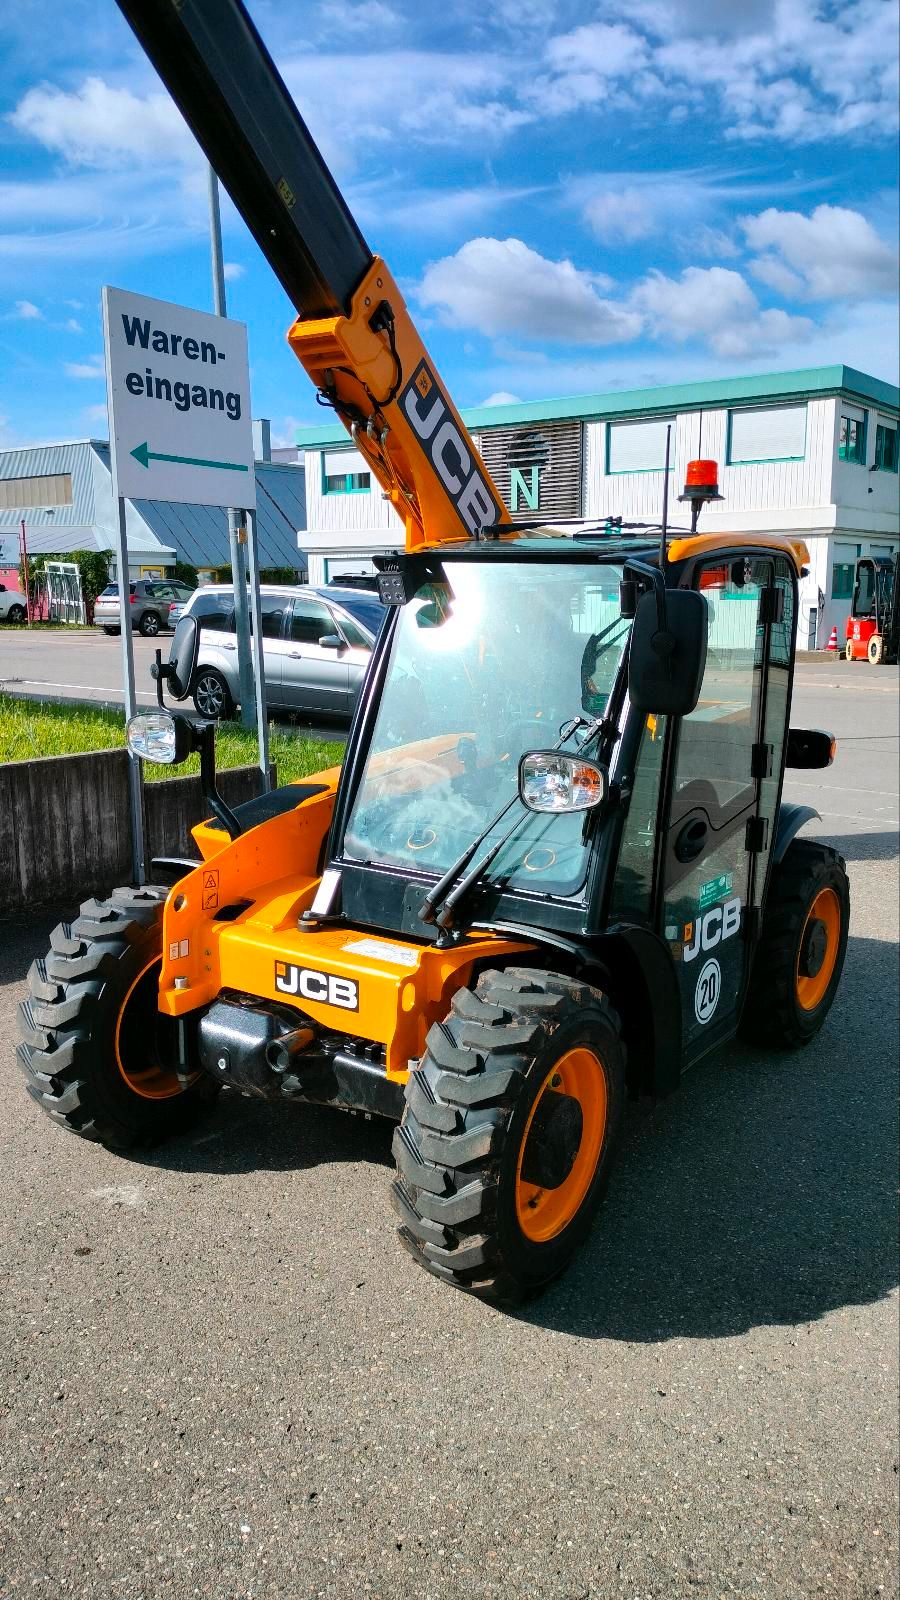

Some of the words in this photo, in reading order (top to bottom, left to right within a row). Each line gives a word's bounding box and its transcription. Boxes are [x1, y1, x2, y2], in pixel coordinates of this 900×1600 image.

[122, 314, 225, 365] Waren-
[125, 368, 241, 421] eingang
[405, 387, 496, 536] JCB
[511, 466, 538, 511] N
[683, 897, 741, 962] JCB
[277, 966, 357, 1008] JCB
[699, 972, 716, 1012] 20
